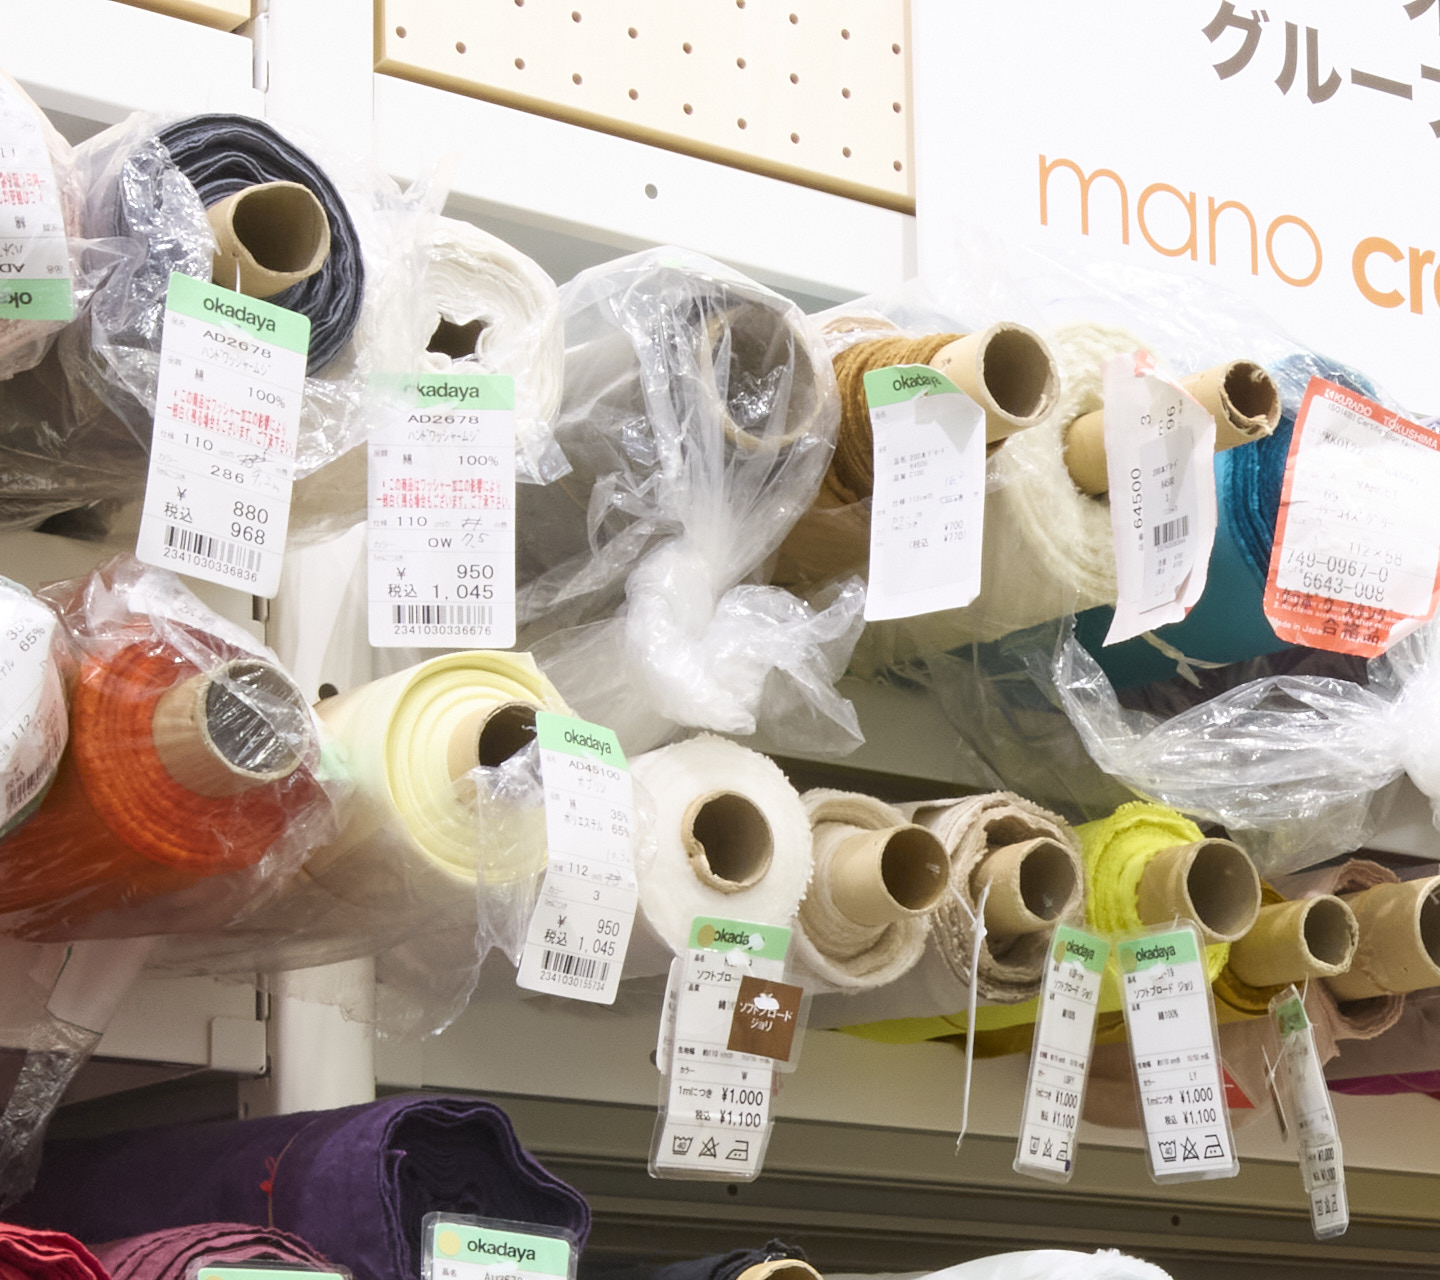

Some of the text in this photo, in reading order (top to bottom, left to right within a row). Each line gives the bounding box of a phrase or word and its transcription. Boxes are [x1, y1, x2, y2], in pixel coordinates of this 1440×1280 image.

[1037, 150, 1322, 290] mano
[203, 297, 275, 332] okadaya
[1383, 416, 1439, 450] TOKUSHIMA
[233, 501, 268, 524] 880
[164, 502, 265, 545] 税込 968
[428, 538, 452, 548] OW
[457, 565, 493, 579] 950
[388, 584, 493, 600] 税込 1,045
[1136, 945, 1176, 962] okadaya
[1180, 1087, 1213, 1103] ¥1,000
[1183, 1108, 1216, 1124] ¥1,100
[468, 1238, 535, 1262] okadaya
